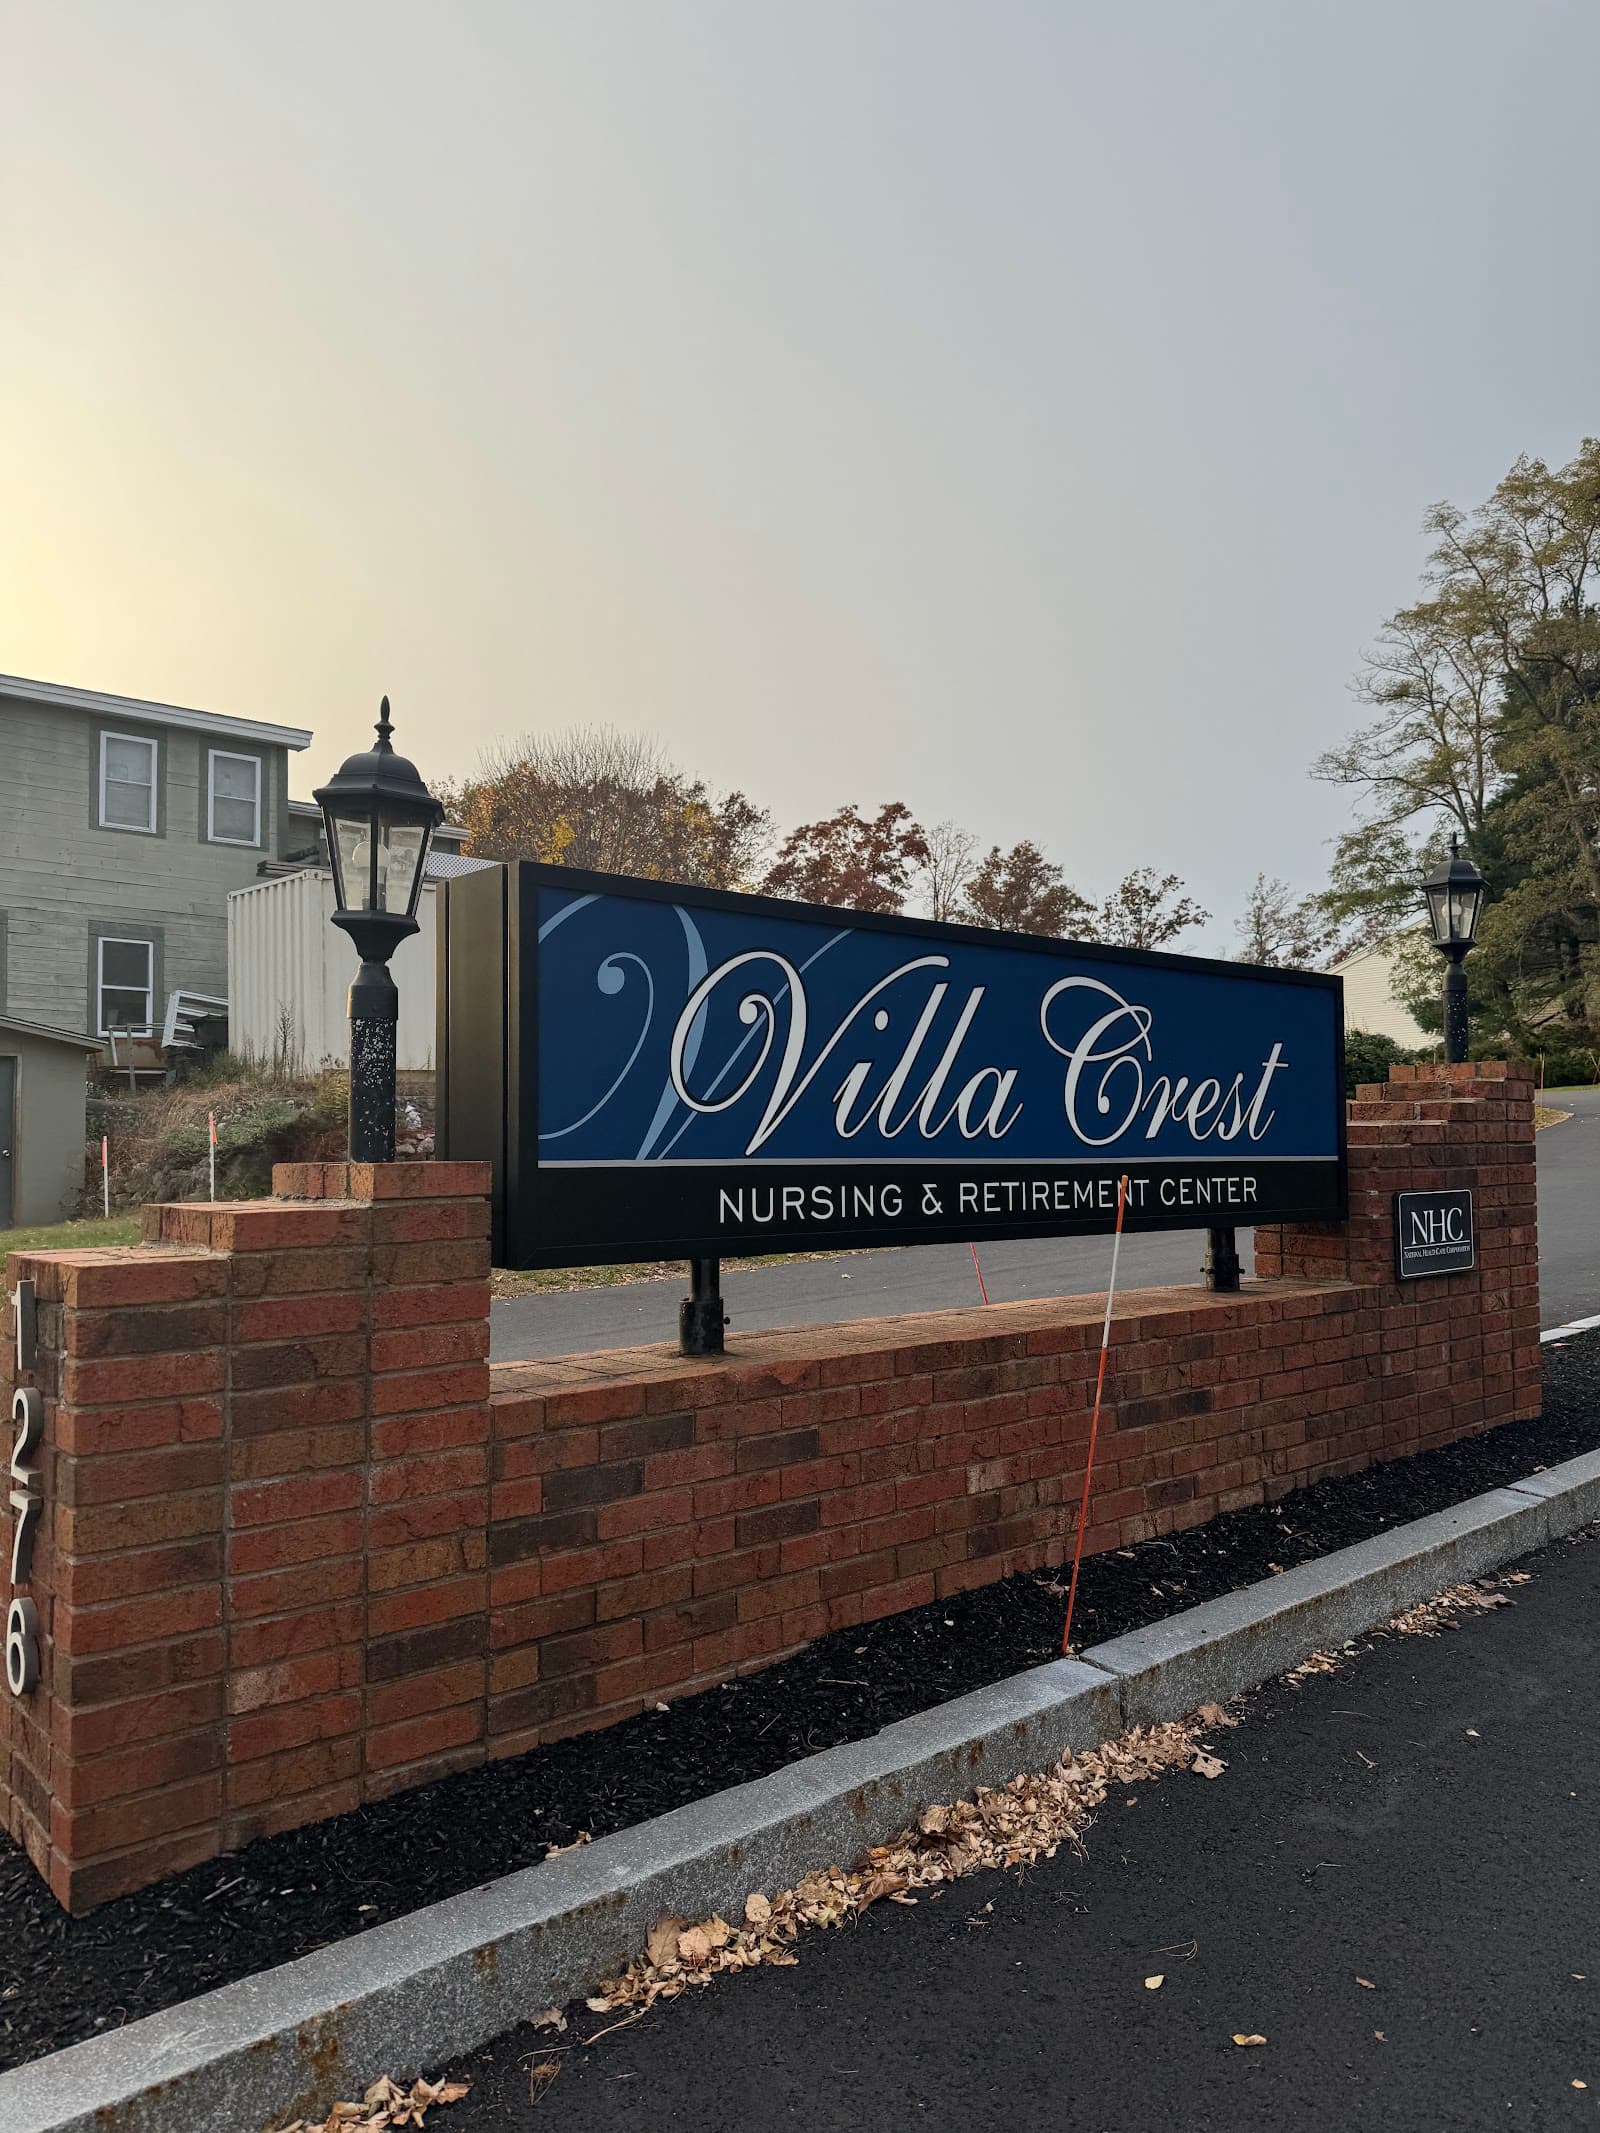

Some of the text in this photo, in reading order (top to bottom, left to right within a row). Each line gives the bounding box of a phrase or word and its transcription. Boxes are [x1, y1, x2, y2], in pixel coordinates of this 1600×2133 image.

[670, 951, 1289, 1156] Villa Crest
[718, 1176, 1258, 1224] NURSING & RETIREMENT CENTER
[1410, 1207, 1464, 1245] NHC
[7, 1280, 41, 1697] 1276
